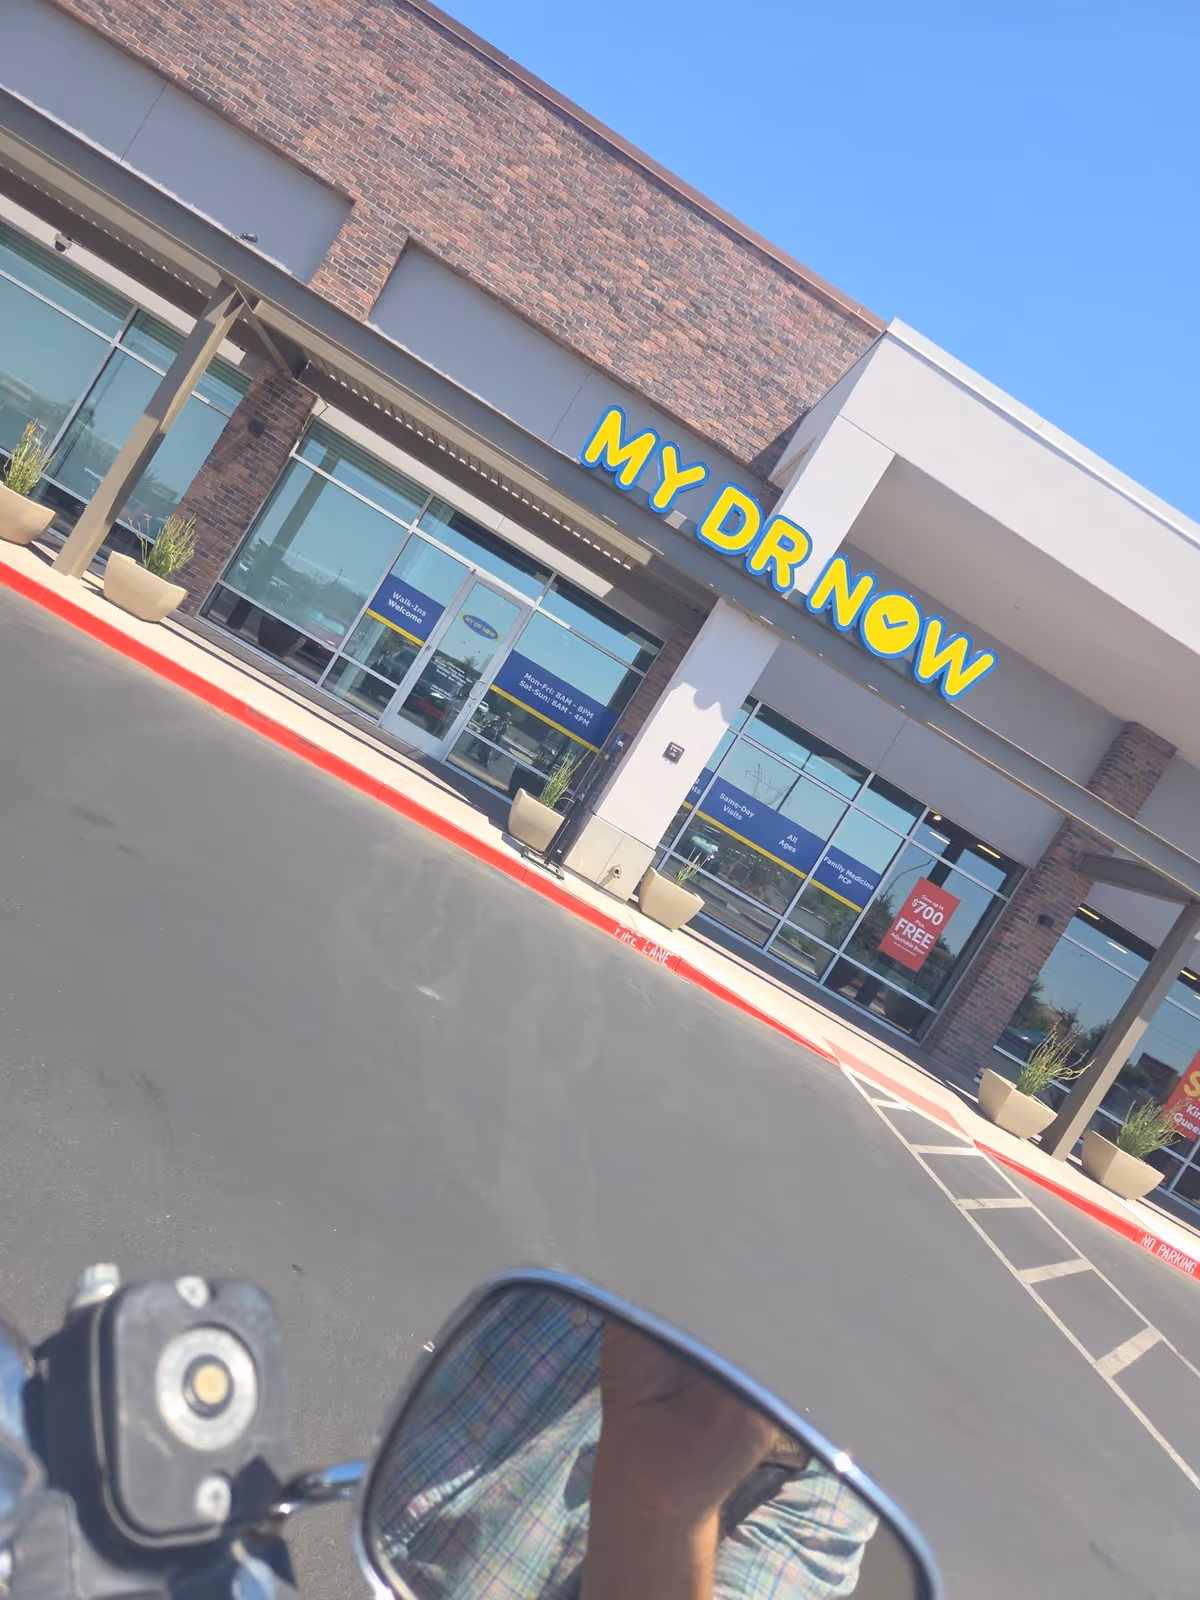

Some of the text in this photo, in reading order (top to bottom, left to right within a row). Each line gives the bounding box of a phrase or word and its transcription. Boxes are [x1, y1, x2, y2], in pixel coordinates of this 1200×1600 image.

[580, 405, 998, 701] MY DR NOW
[388, 598, 423, 625] Welcome
[392, 591, 427, 617] Walk-Ins
[519, 680, 551, 703] Sat-Sun:
[551, 699, 569, 713] 8AM
[573, 714, 591, 727] 4PM
[523, 672, 555, 696] Mon-Fri:
[555, 692, 573, 706] 8AM
[577, 705, 594, 719] 8PM
[719, 792, 756, 819] Same-Day
[723, 804, 743, 820] Visits
[778, 839, 797, 853] Ages
[786, 834, 799, 844] All
[823, 856, 875, 891] Family Medicine
[837, 874, 852, 885] PCP
[911, 898, 944, 926] $700
[614, 922, 673, 967] FIRE LANE
[894, 917, 935, 949] FREE
[1141, 1233, 1197, 1275] NO PARKING
